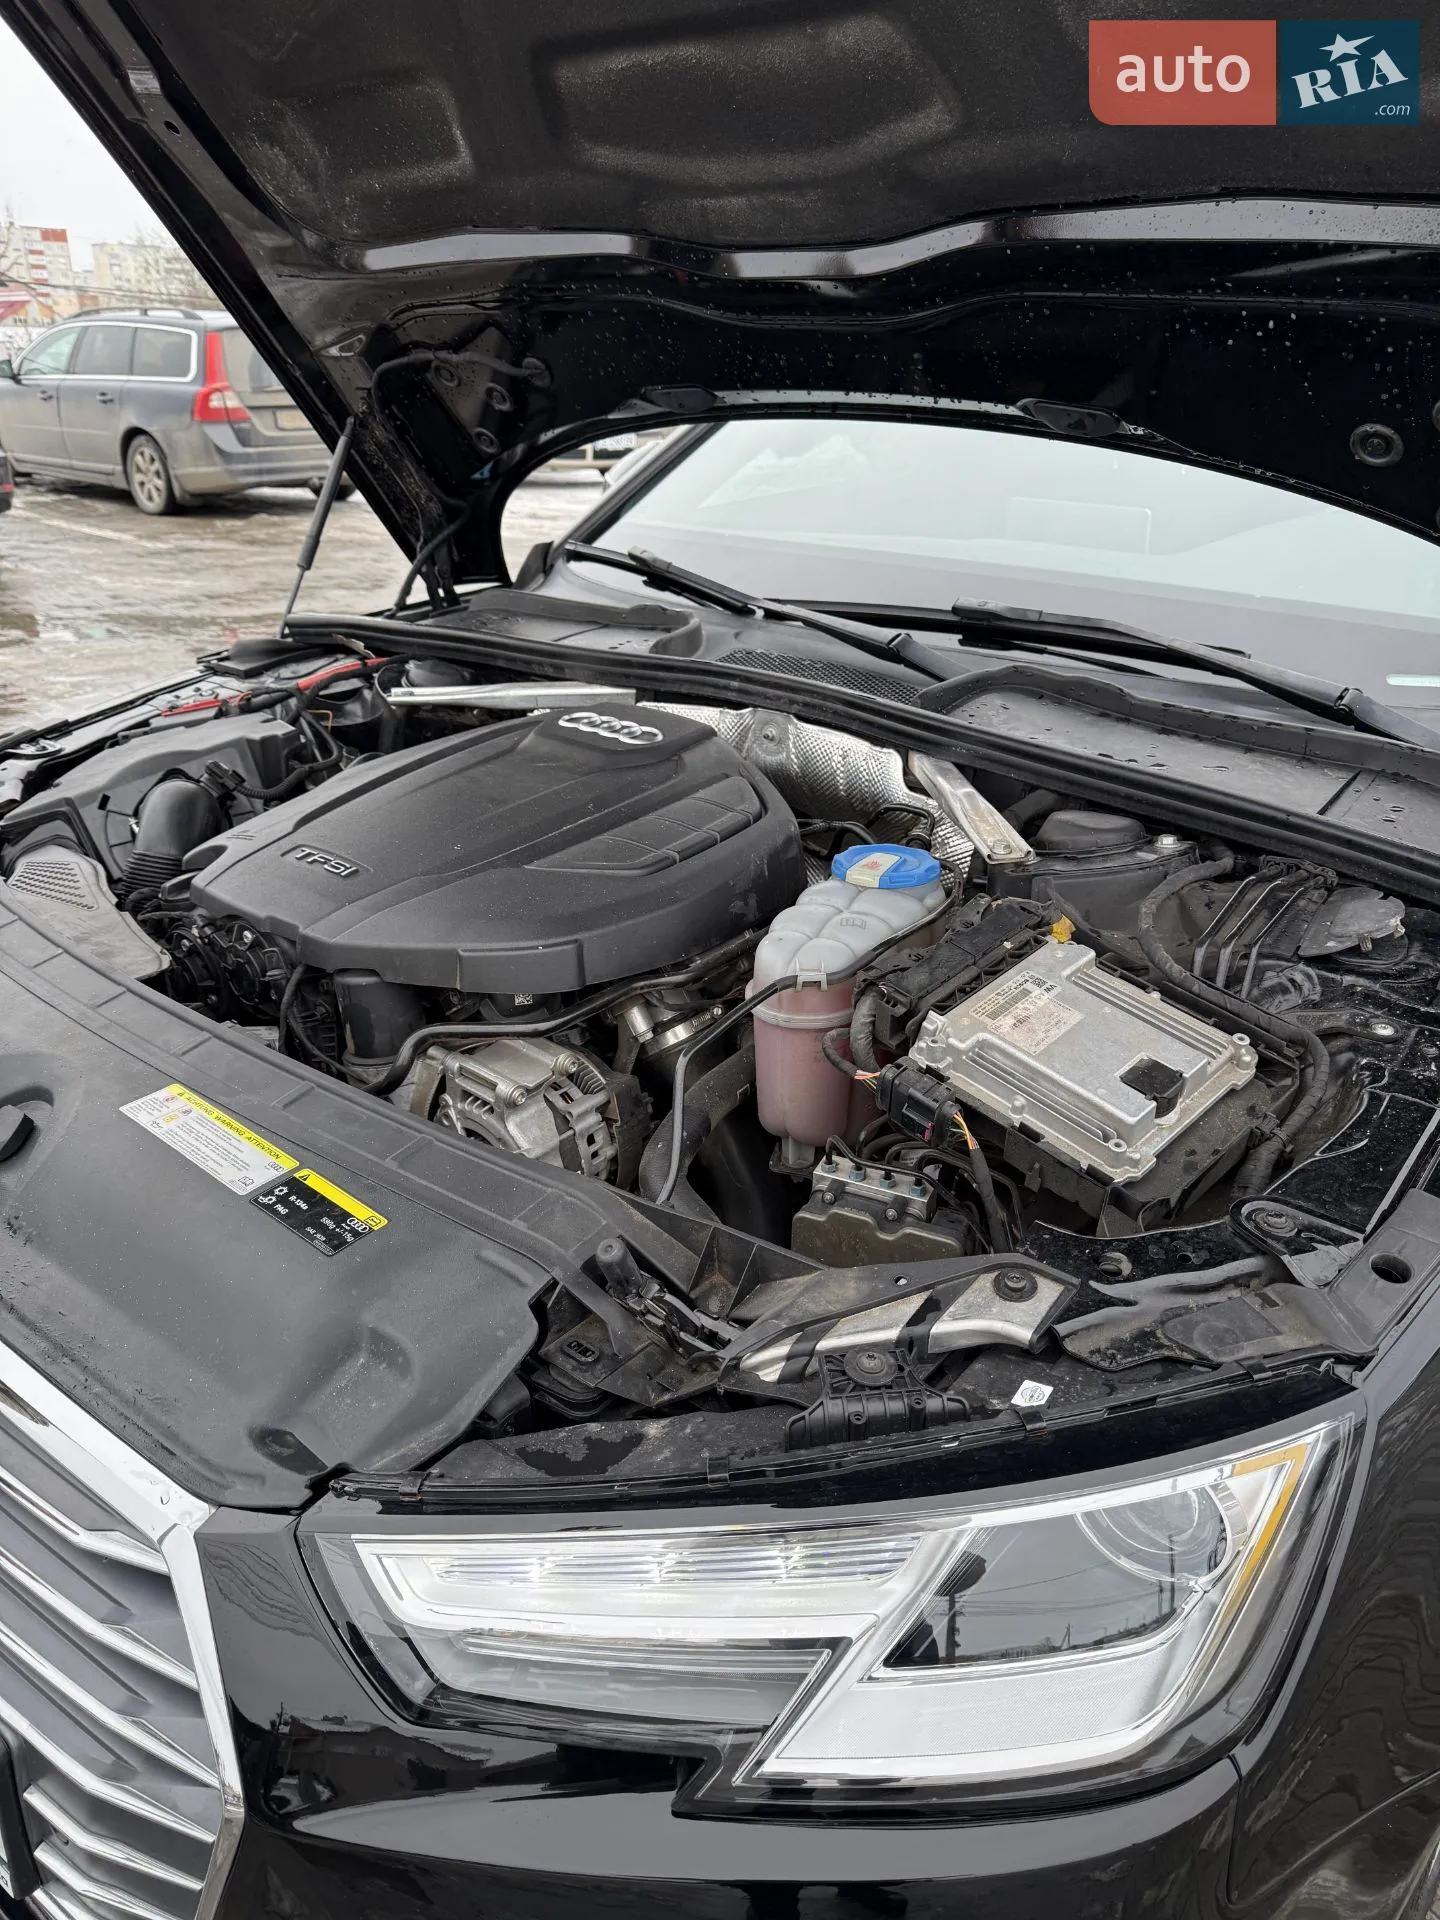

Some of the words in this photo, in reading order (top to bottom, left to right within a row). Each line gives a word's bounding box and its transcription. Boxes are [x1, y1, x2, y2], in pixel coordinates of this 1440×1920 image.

[295, 848, 358, 877] TFSI
[185, 1097, 214, 1115] ACHTUNG
[214, 1115, 245, 1136] WARNING
[244, 1135, 282, 1160] ATTENTION
[273, 1204, 288, 1214] PAG
